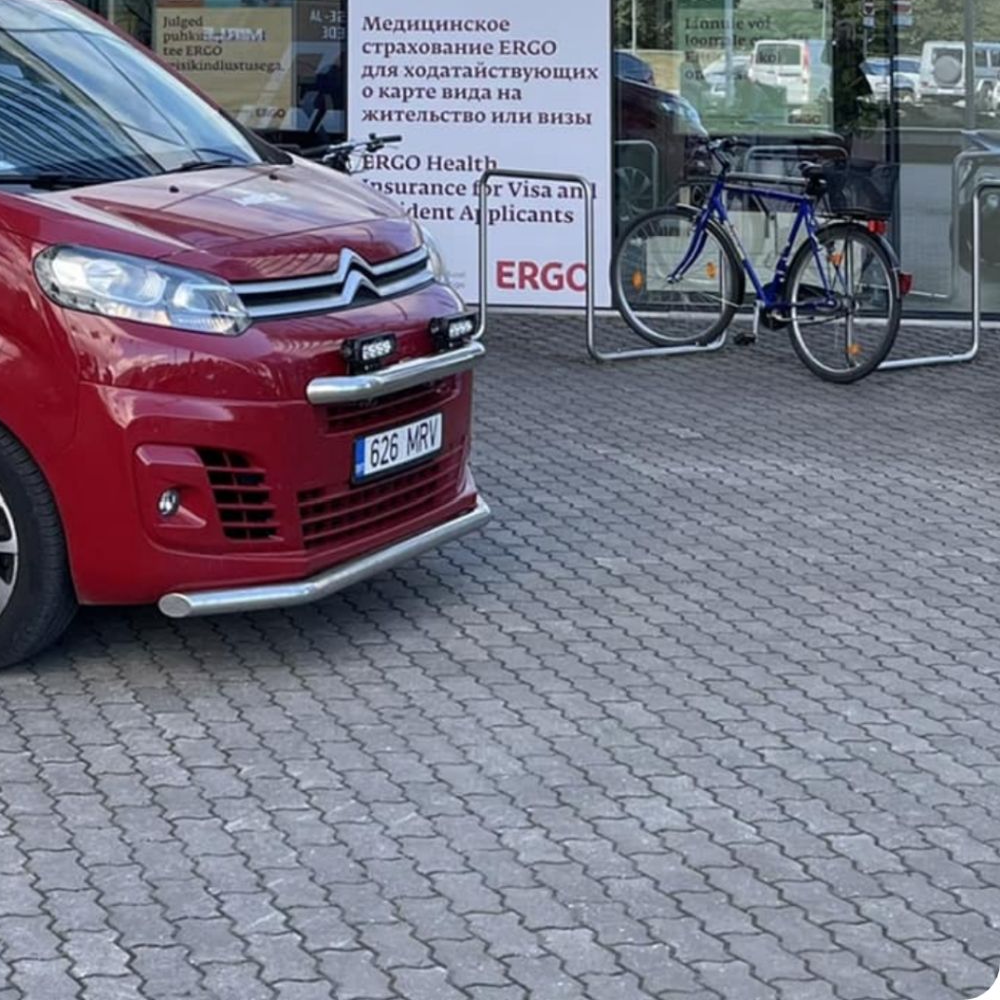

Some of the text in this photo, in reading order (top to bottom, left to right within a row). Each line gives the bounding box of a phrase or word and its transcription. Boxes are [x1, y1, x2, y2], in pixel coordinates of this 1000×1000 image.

[163, 16, 203, 29] Julged
[362, 16, 511, 33] Медицинское
[185, 45, 222, 56] ERGO
[362, 40, 557, 58] страхование ERGO
[361, 61, 599, 82] для ходатайствующих
[362, 86, 522, 102] о карте вида на
[361, 109, 592, 125] жительство или визы
[363, 154, 497, 172] ERGO Health
[363, 179, 467, 196] nsurance
[508, 181, 552, 198] Visa
[496, 260, 588, 292] ERGO
[370, 418, 439, 467] 626 MRV
